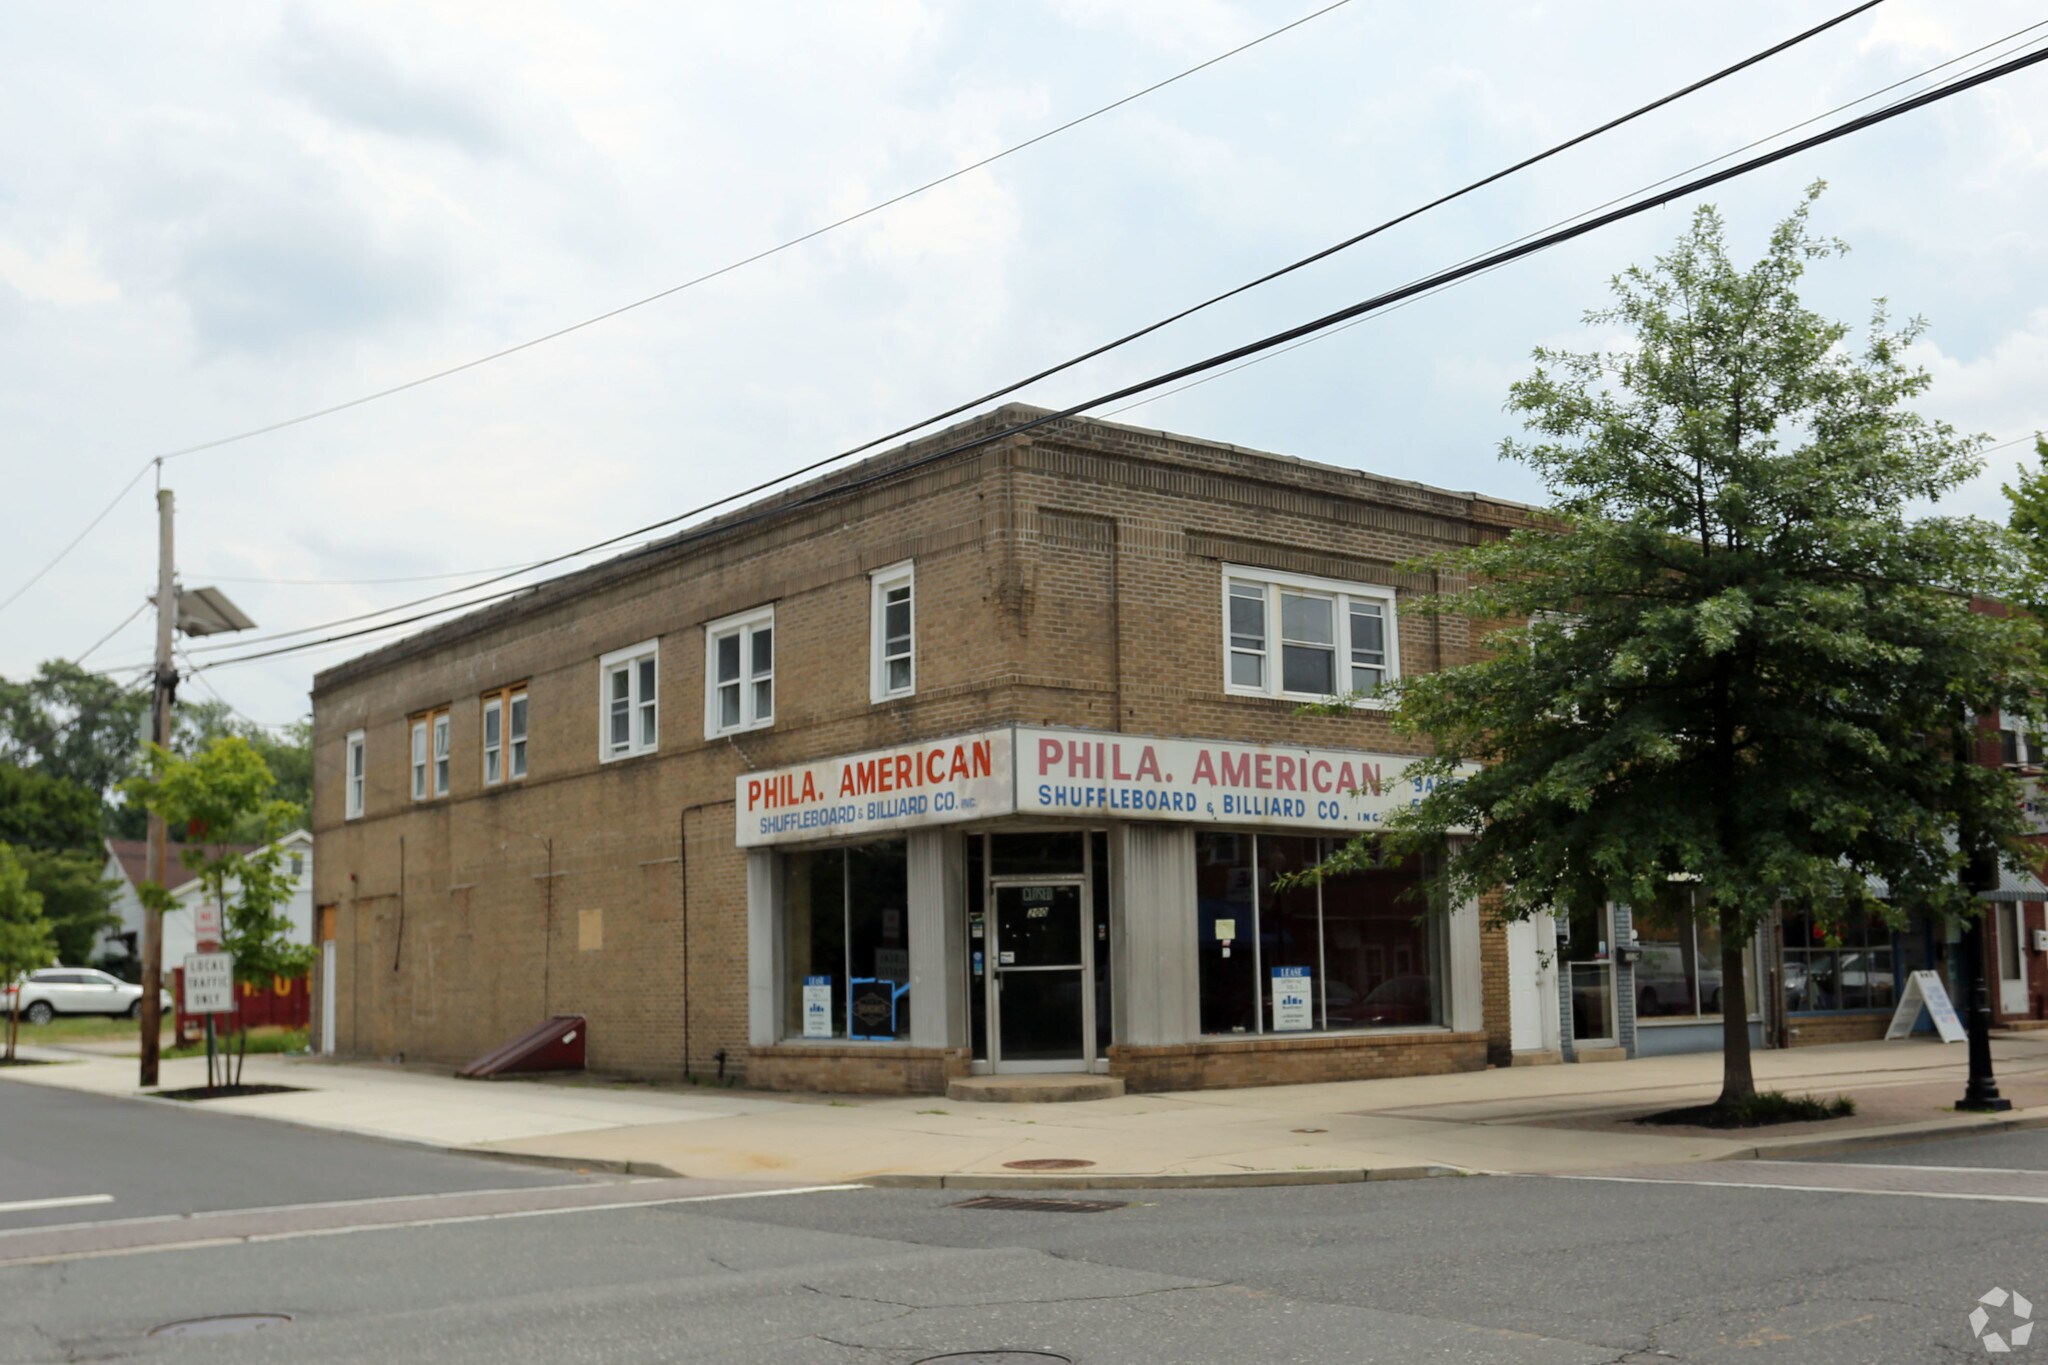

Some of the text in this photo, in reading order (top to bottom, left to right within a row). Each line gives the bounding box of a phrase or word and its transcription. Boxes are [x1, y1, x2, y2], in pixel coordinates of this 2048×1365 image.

[748, 739, 991, 812] PHILA. AMERICAN
[1038, 738, 1381, 797] PHILA. AMERICAN
[760, 804, 856, 835] SHUFFLEBOARD
[867, 794, 928, 821] BILLIARD
[934, 791, 959, 812] CO.
[1038, 784, 1197, 812] SHUFFLEBOARD
[1223, 794, 1306, 818] BILLIARD
[1317, 800, 1348, 821] CO.
[190, 960, 225, 972] LOCAL
[1280, 967, 1303, 977] LEASE
